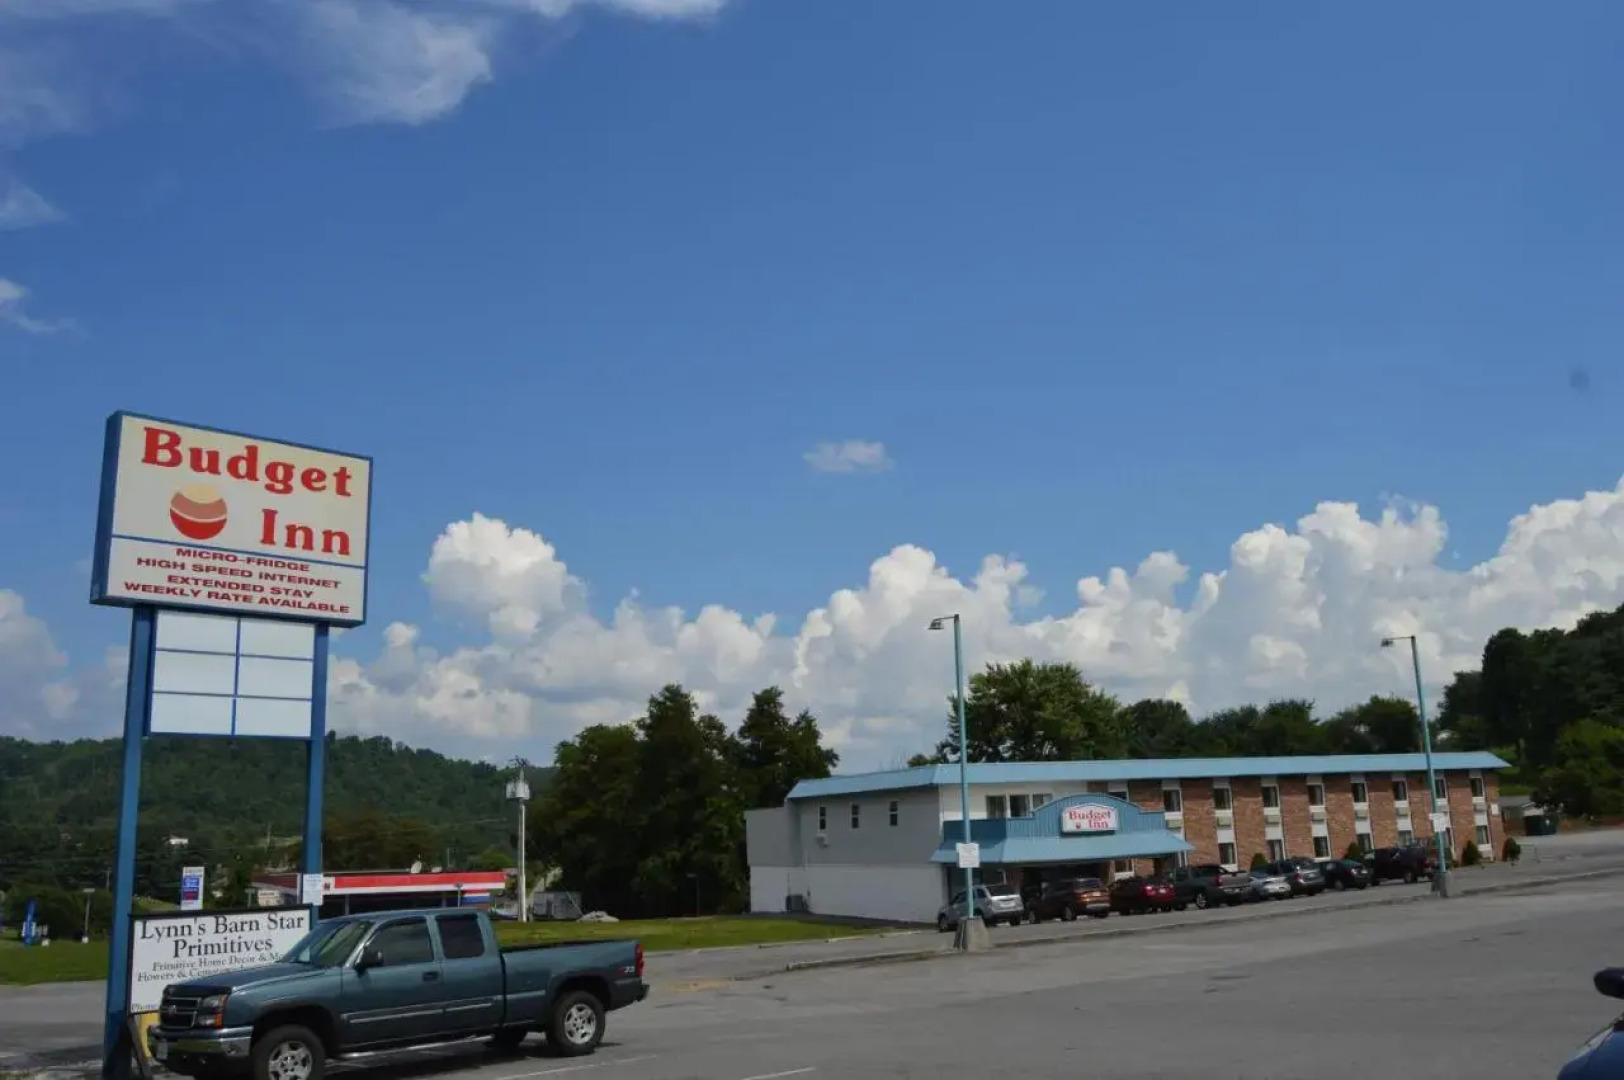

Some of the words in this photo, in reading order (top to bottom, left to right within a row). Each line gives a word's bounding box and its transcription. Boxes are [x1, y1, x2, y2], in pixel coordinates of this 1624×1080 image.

[141, 426, 352, 497] Budget
[259, 508, 350, 556] Inn
[175, 548, 310, 572] MICRO-FRIDGE
[136, 557, 187, 573] HIGH
[191, 562, 254, 579] SPEED
[258, 571, 342, 589] INTERNET
[124, 582, 201, 598] WEEKLY
[206, 590, 253, 604] RATE
[258, 597, 350, 614] AVAILABLE
[166, 574, 265, 594] EXTENDED
[269, 586, 314, 599] STAY
[1068, 809, 1111, 821] Budget
[1088, 819, 1109, 829] Inn
[140, 917, 206, 943] Lynn's
[213, 914, 261, 935] Barn
[267, 912, 304, 930] Star
[172, 936, 273, 959] Primitives
[199, 957, 226, 967] Home
[229, 954, 256, 965] Decor
